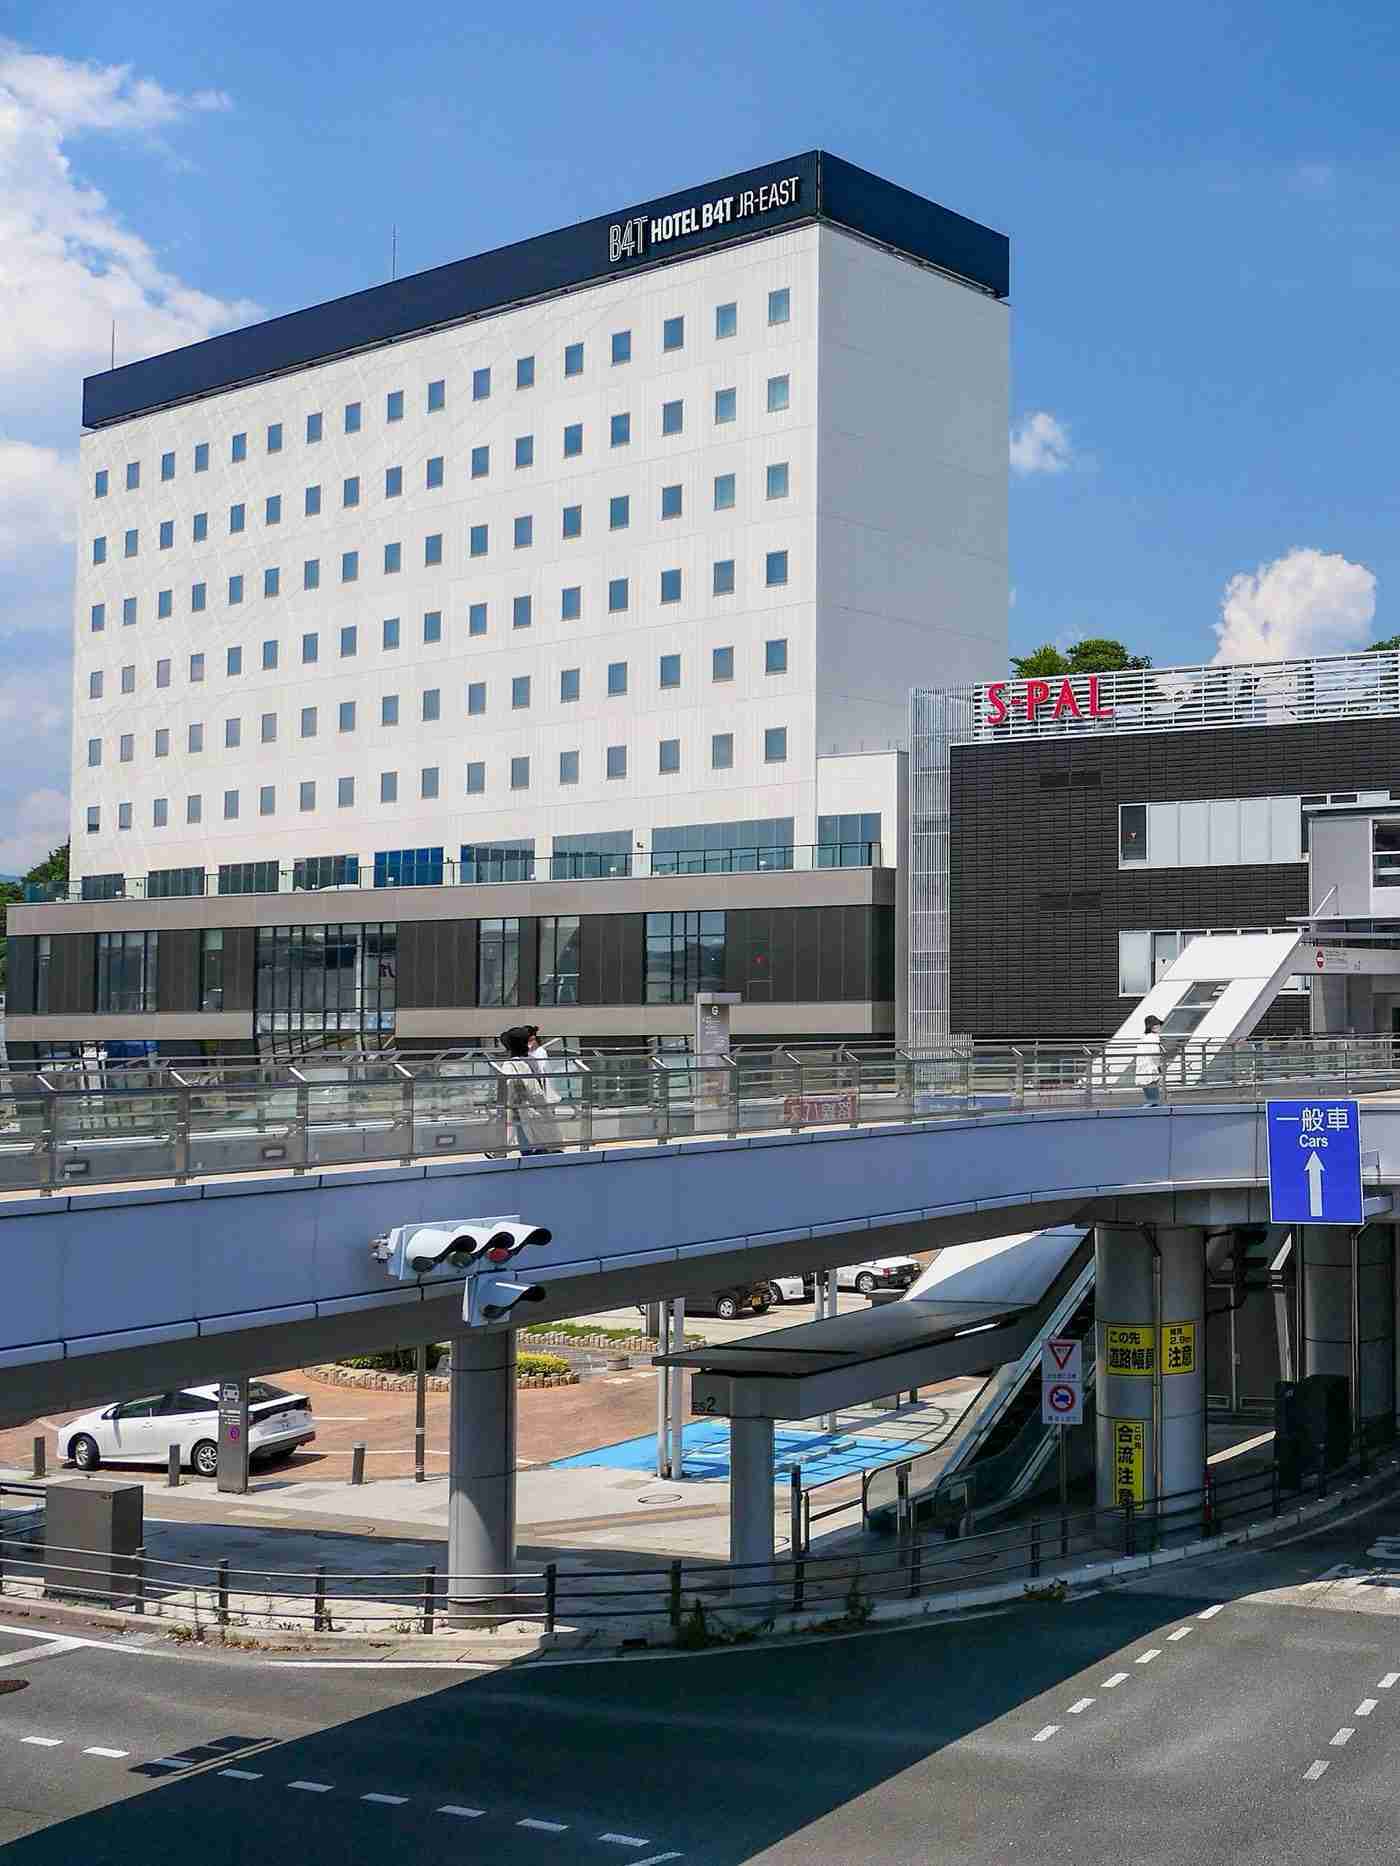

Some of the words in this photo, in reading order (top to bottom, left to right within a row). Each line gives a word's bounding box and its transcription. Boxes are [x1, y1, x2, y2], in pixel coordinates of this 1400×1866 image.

[651, 207, 699, 244] HOTEL
[702, 196, 733, 229] B4T
[736, 176, 799, 219] JR-EAST
[609, 216, 648, 262] B4T
[986, 675, 1115, 725] S-PAL
[1276, 1107, 1350, 1132] 一般車
[1299, 1134, 1328, 1148] Cars
[1110, 1331, 1141, 1345] この先
[1168, 1345, 1193, 1368] 注意
